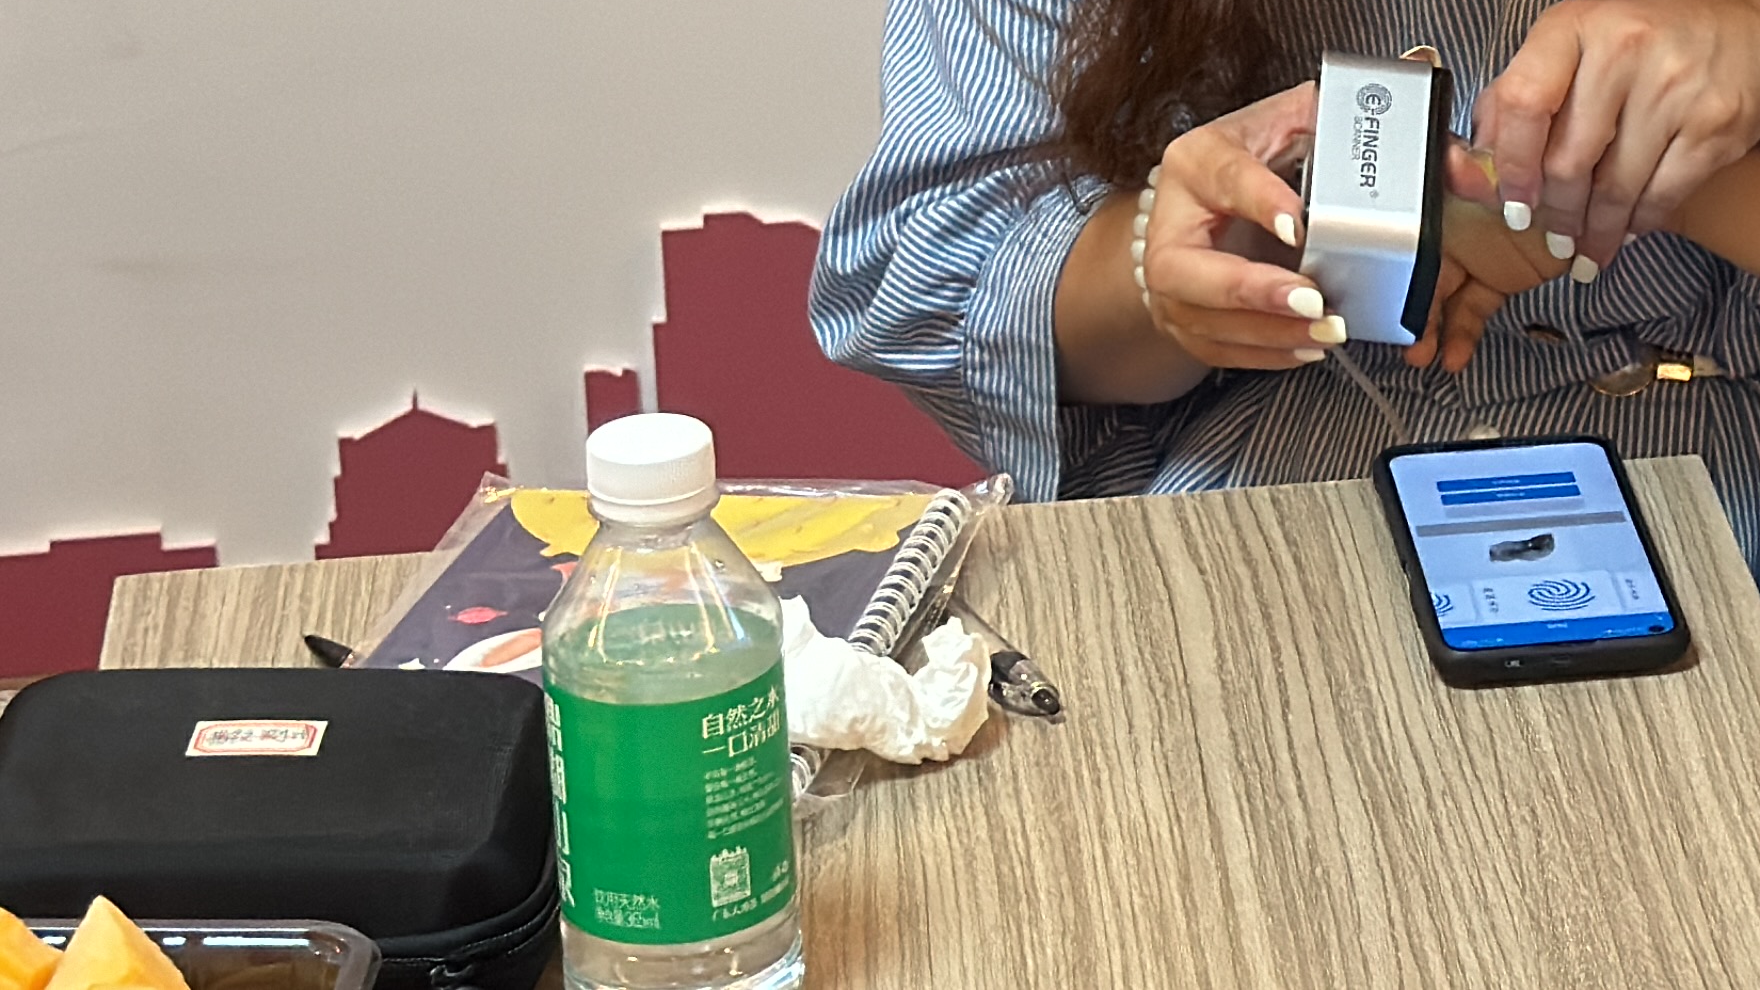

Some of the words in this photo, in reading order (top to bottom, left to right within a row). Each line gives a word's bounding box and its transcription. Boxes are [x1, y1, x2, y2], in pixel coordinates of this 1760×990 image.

[1351, 115, 1363, 161] SCANNER
[702, 685, 779, 739] 自然之水
[702, 708, 779, 758] 一口清甜
